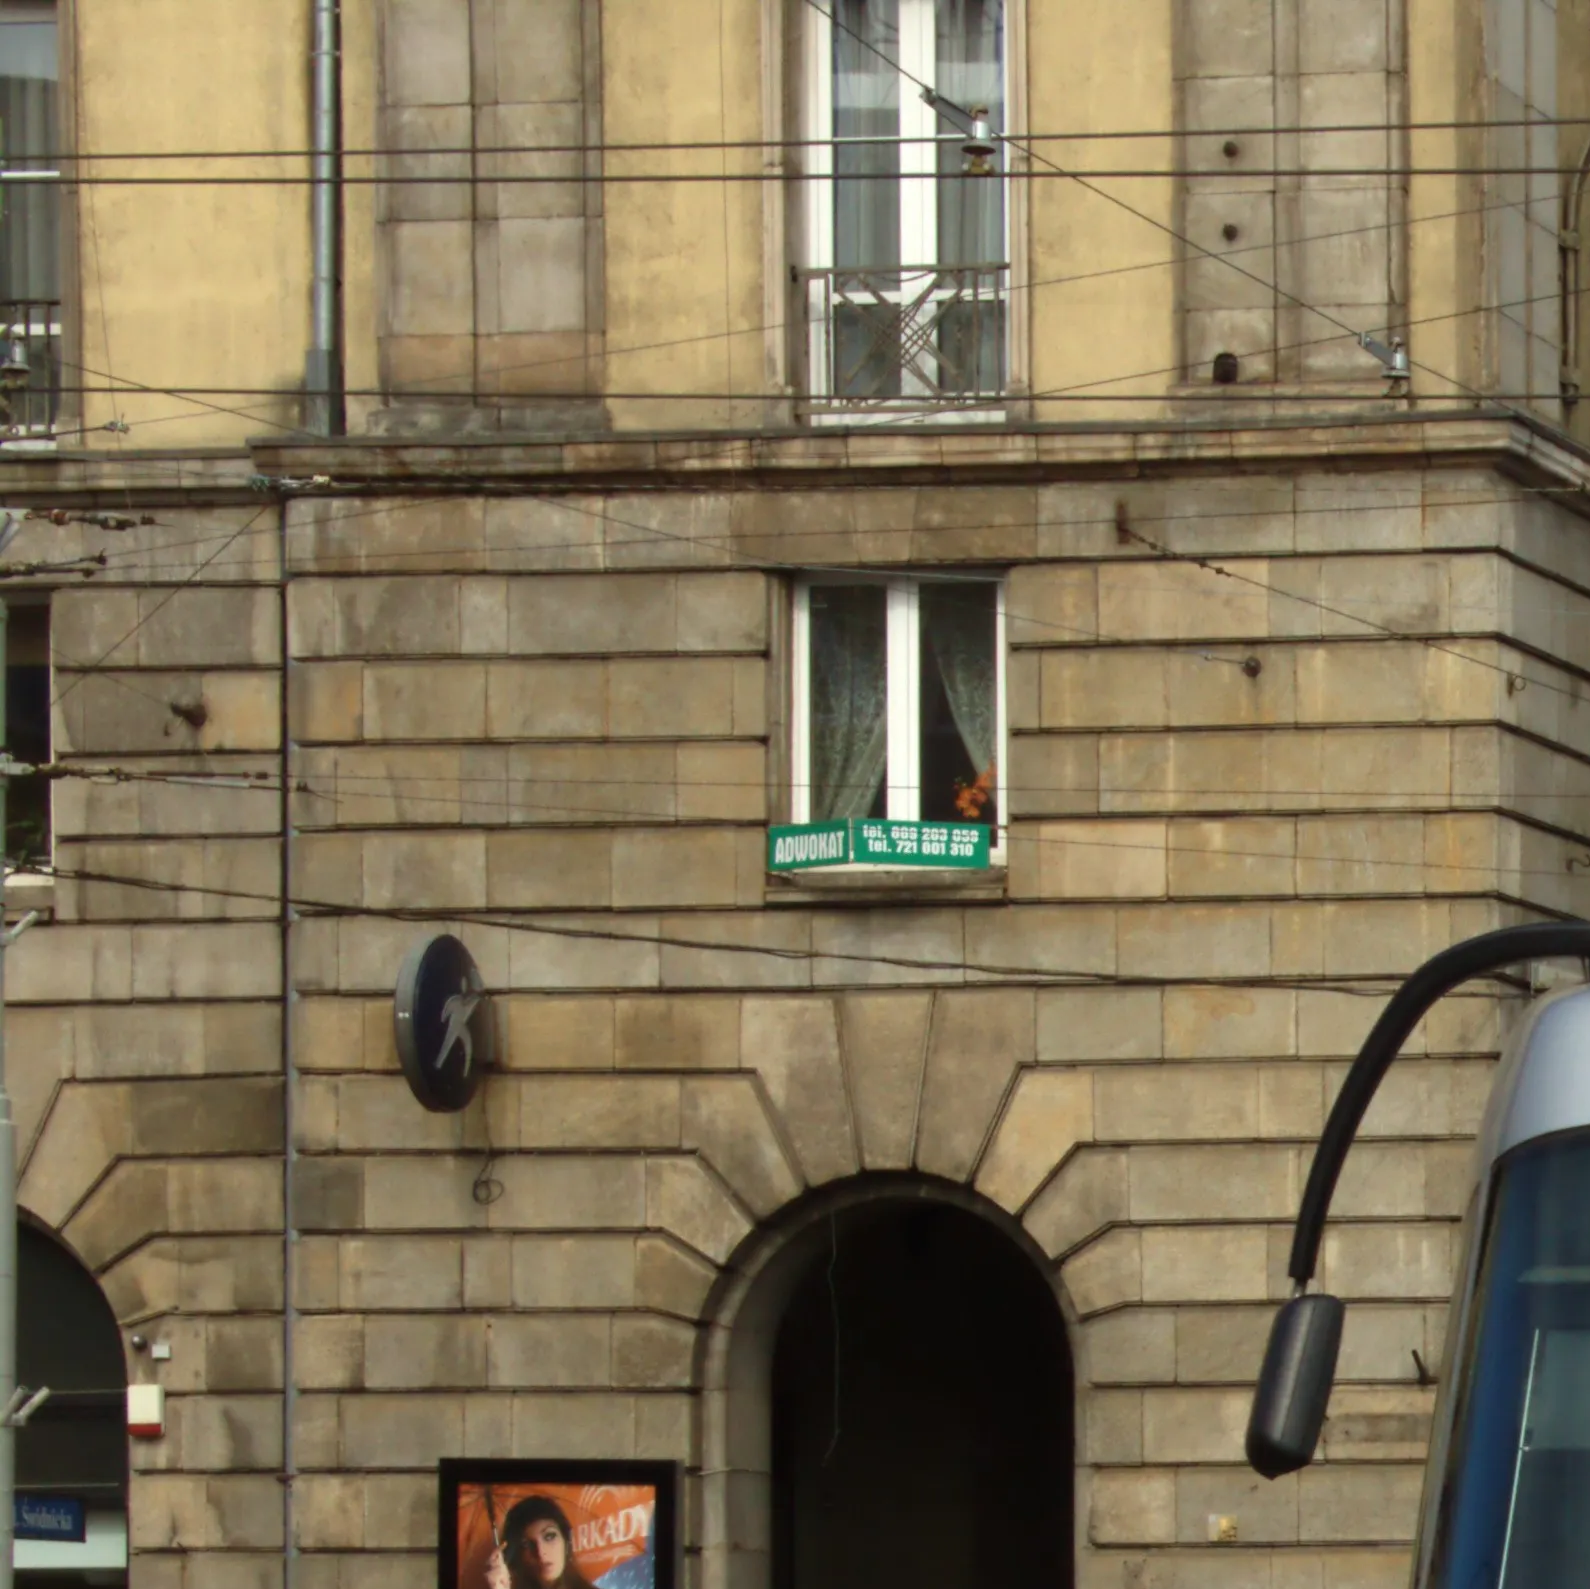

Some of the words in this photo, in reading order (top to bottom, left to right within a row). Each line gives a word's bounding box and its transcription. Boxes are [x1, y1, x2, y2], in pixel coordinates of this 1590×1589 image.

[862, 823, 887, 839] tel.
[775, 831, 844, 864] ADWOKAT
[867, 839, 892, 853] tel.
[895, 840, 918, 855] 721
